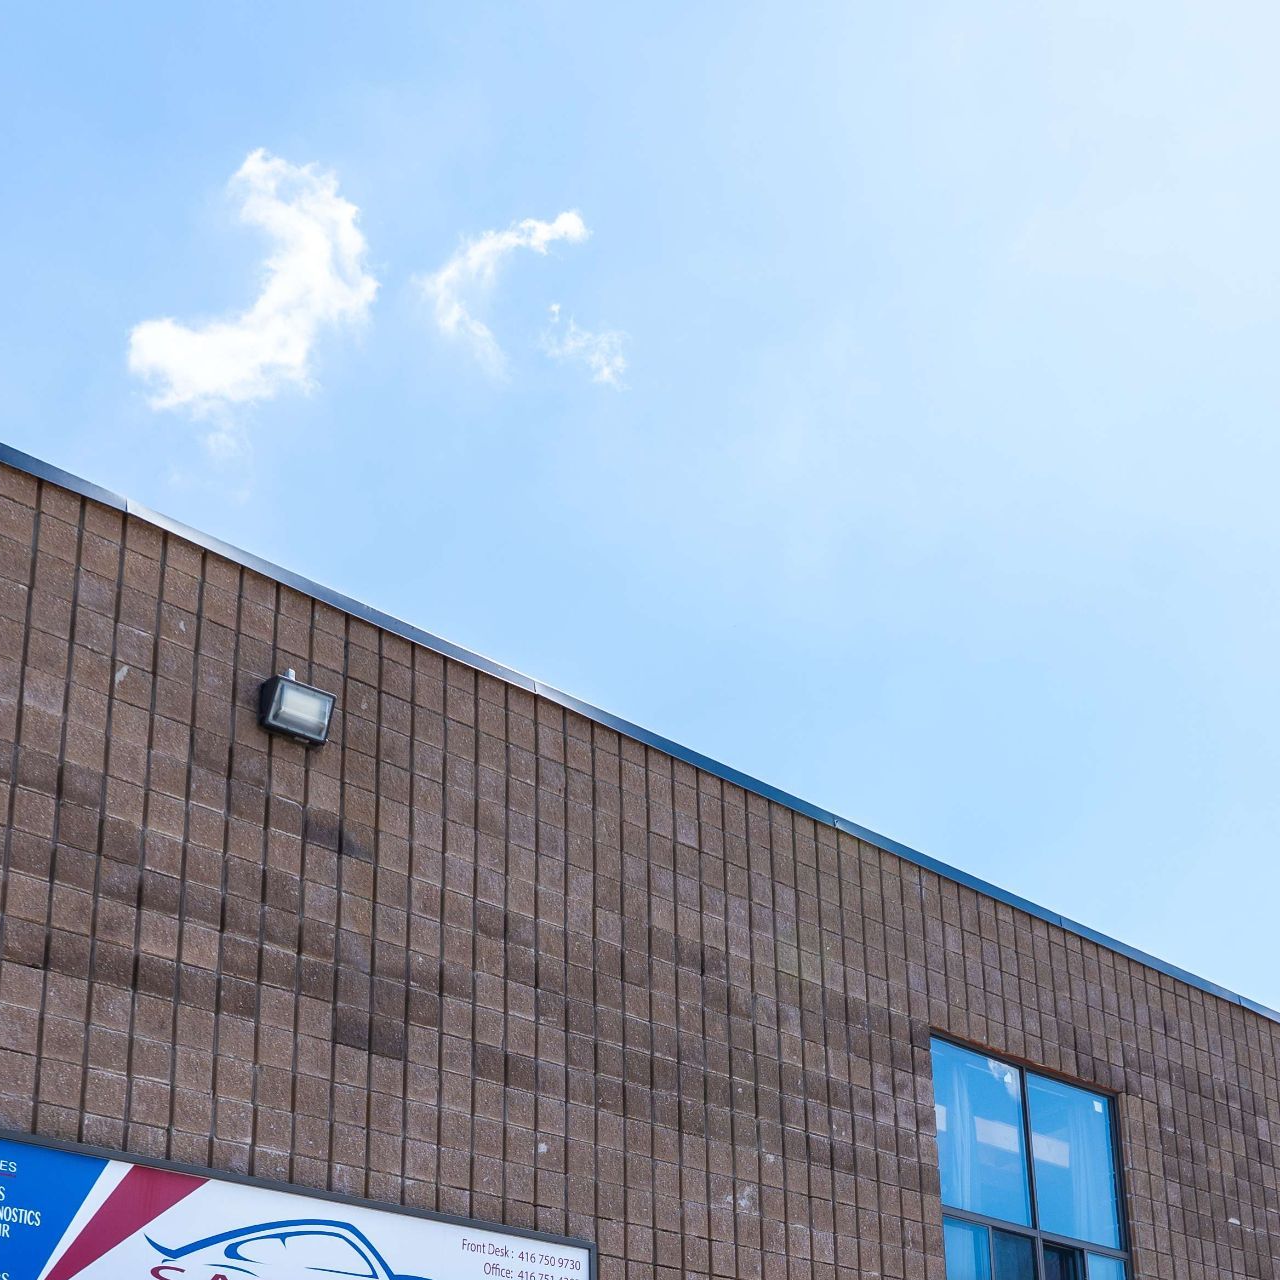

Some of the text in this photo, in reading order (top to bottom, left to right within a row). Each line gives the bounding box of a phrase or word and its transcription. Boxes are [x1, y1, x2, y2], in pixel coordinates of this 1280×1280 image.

[462, 1238, 485, 1254] Front
[488, 1243, 509, 1258] Desk
[518, 1251, 536, 1263] 416
[538, 1253, 556, 1267] 750
[557, 1257, 581, 1271] 9730
[483, 1262, 513, 1279] Office:
